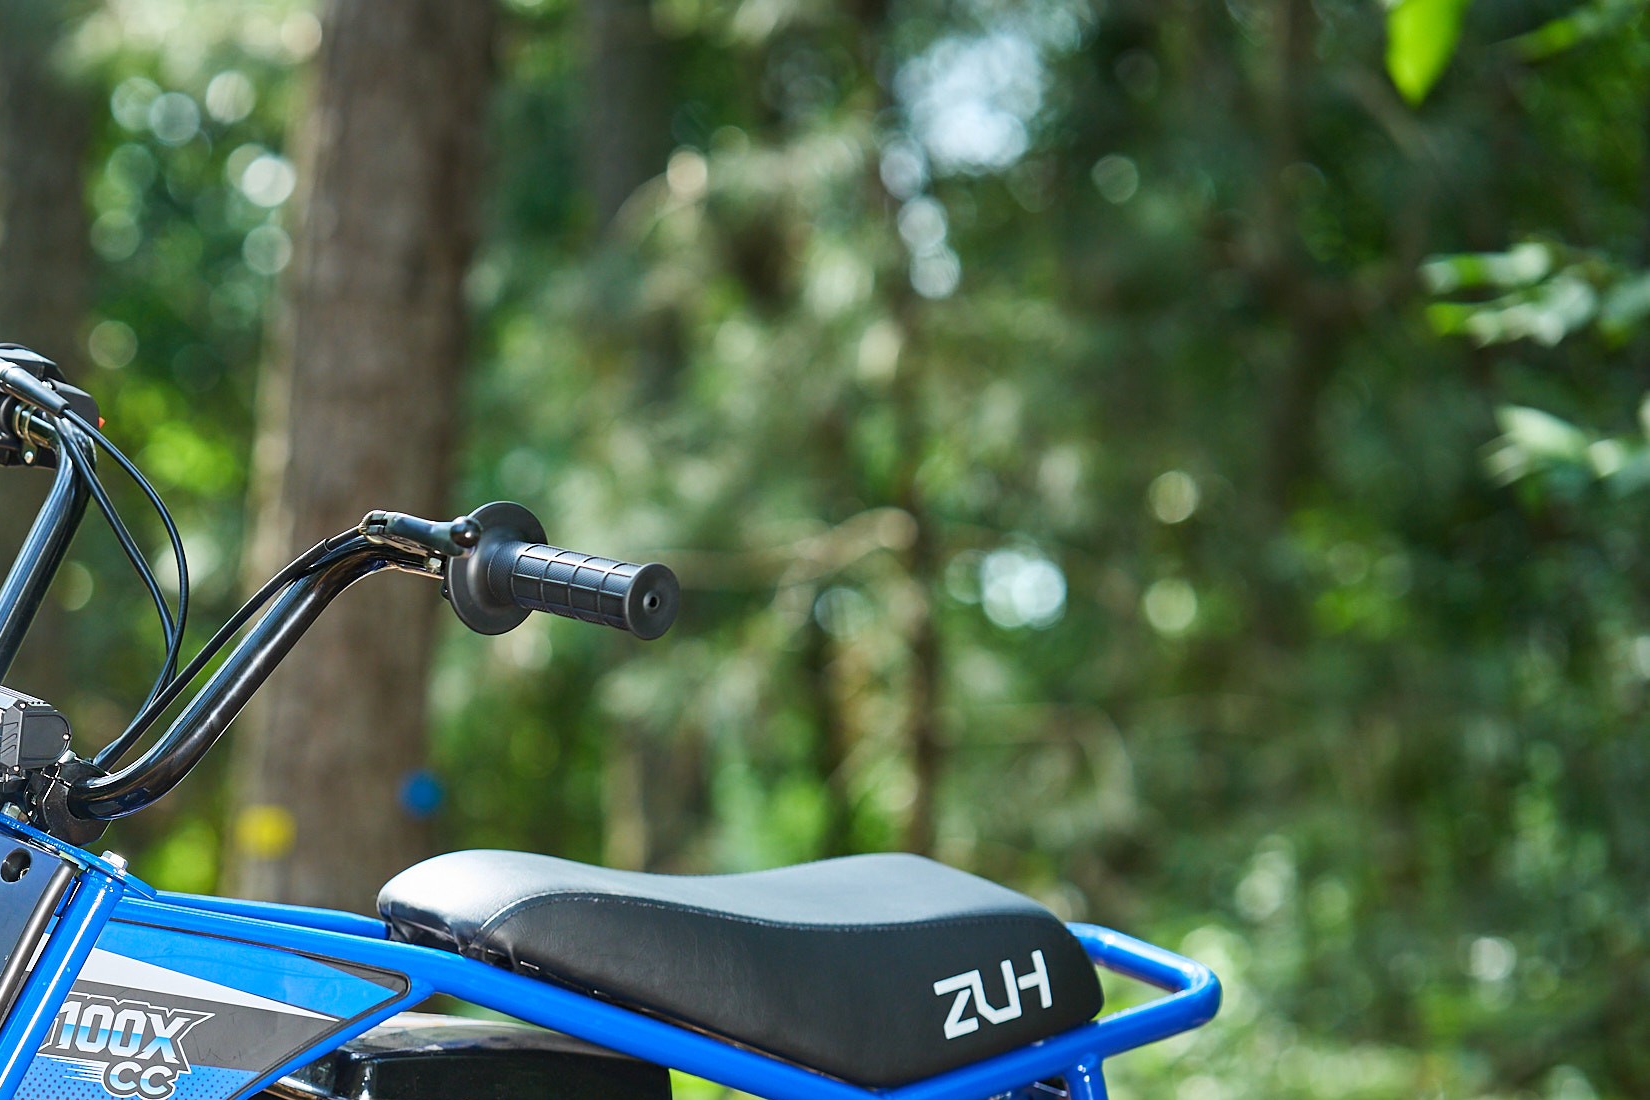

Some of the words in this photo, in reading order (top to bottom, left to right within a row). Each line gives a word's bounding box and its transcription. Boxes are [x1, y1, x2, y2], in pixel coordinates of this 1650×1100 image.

[933, 948, 1053, 1040] ZUH
[55, 1000, 192, 1065] 100X
[108, 1060, 173, 1096] CC
